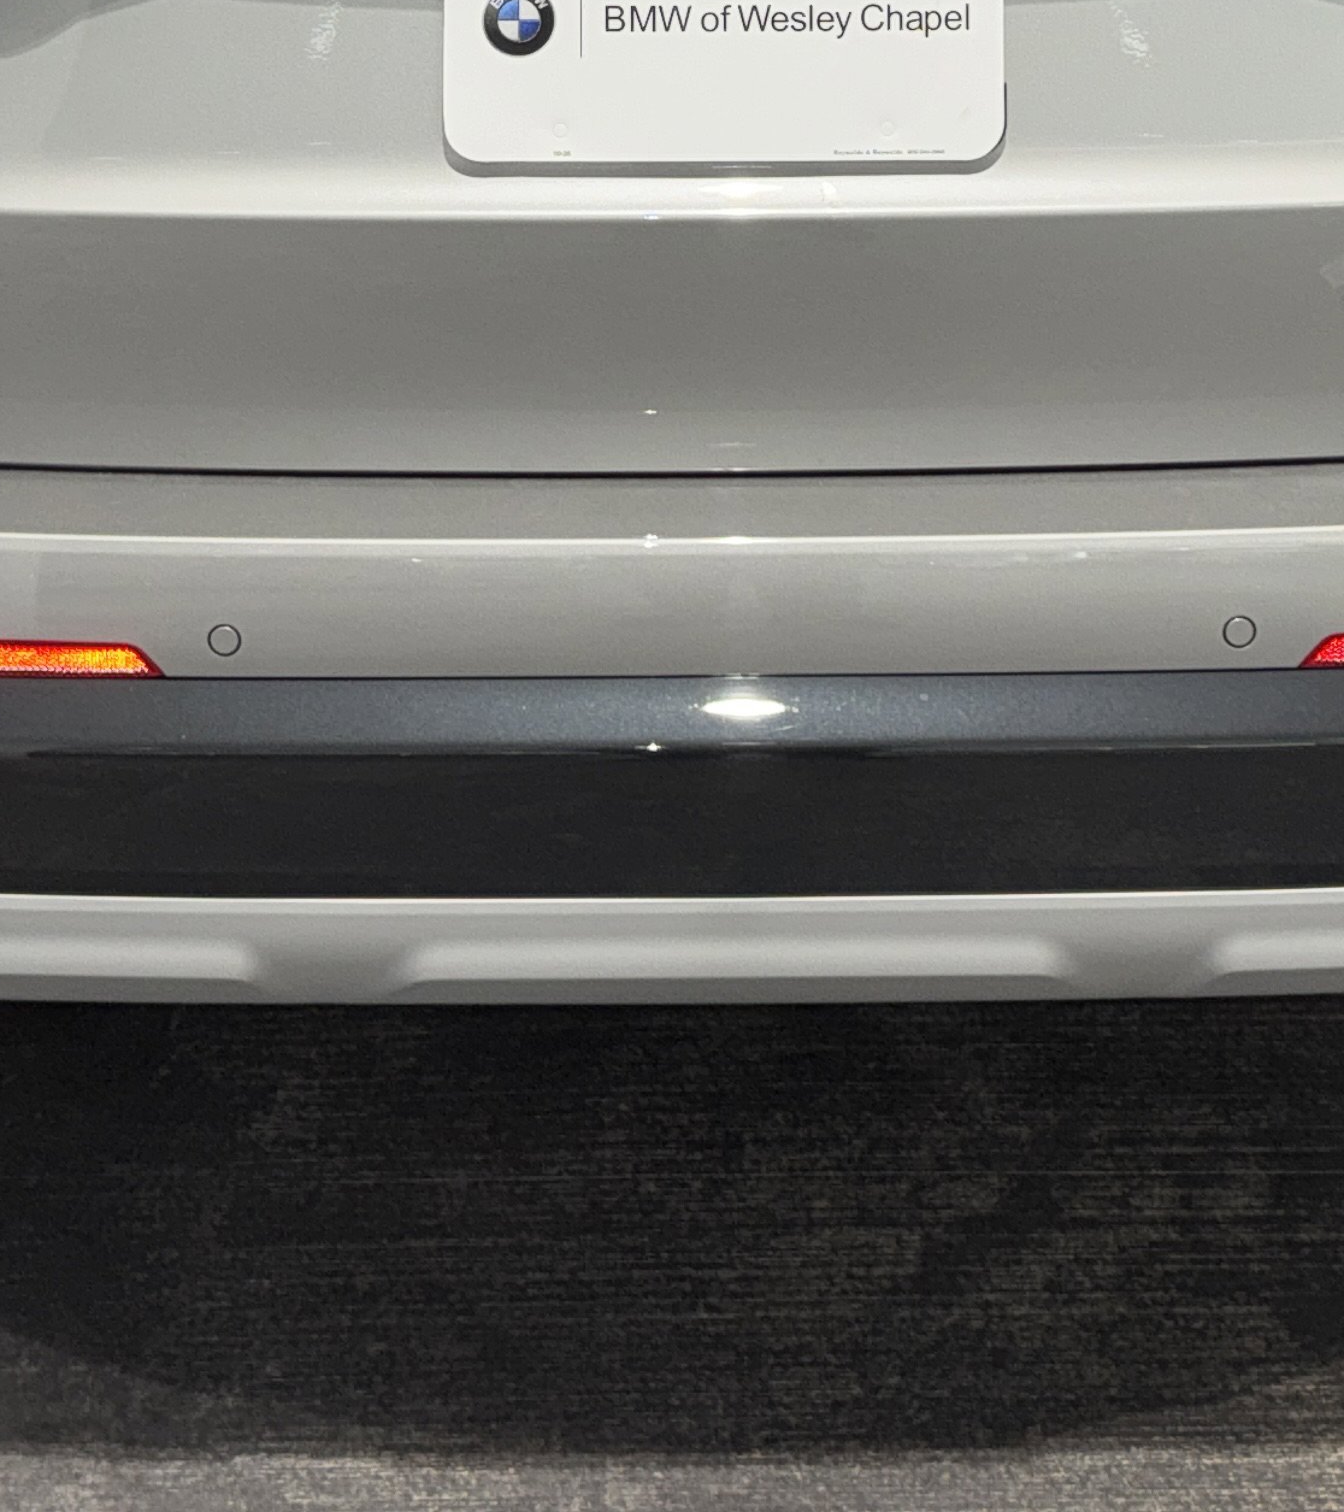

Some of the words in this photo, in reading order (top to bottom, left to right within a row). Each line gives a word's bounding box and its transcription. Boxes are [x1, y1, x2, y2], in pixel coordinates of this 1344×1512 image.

[604, 4, 692, 33] BMW
[700, 4, 732, 32] of
[737, 3, 852, 38] Wesley
[859, 2, 971, 38] Chapel
